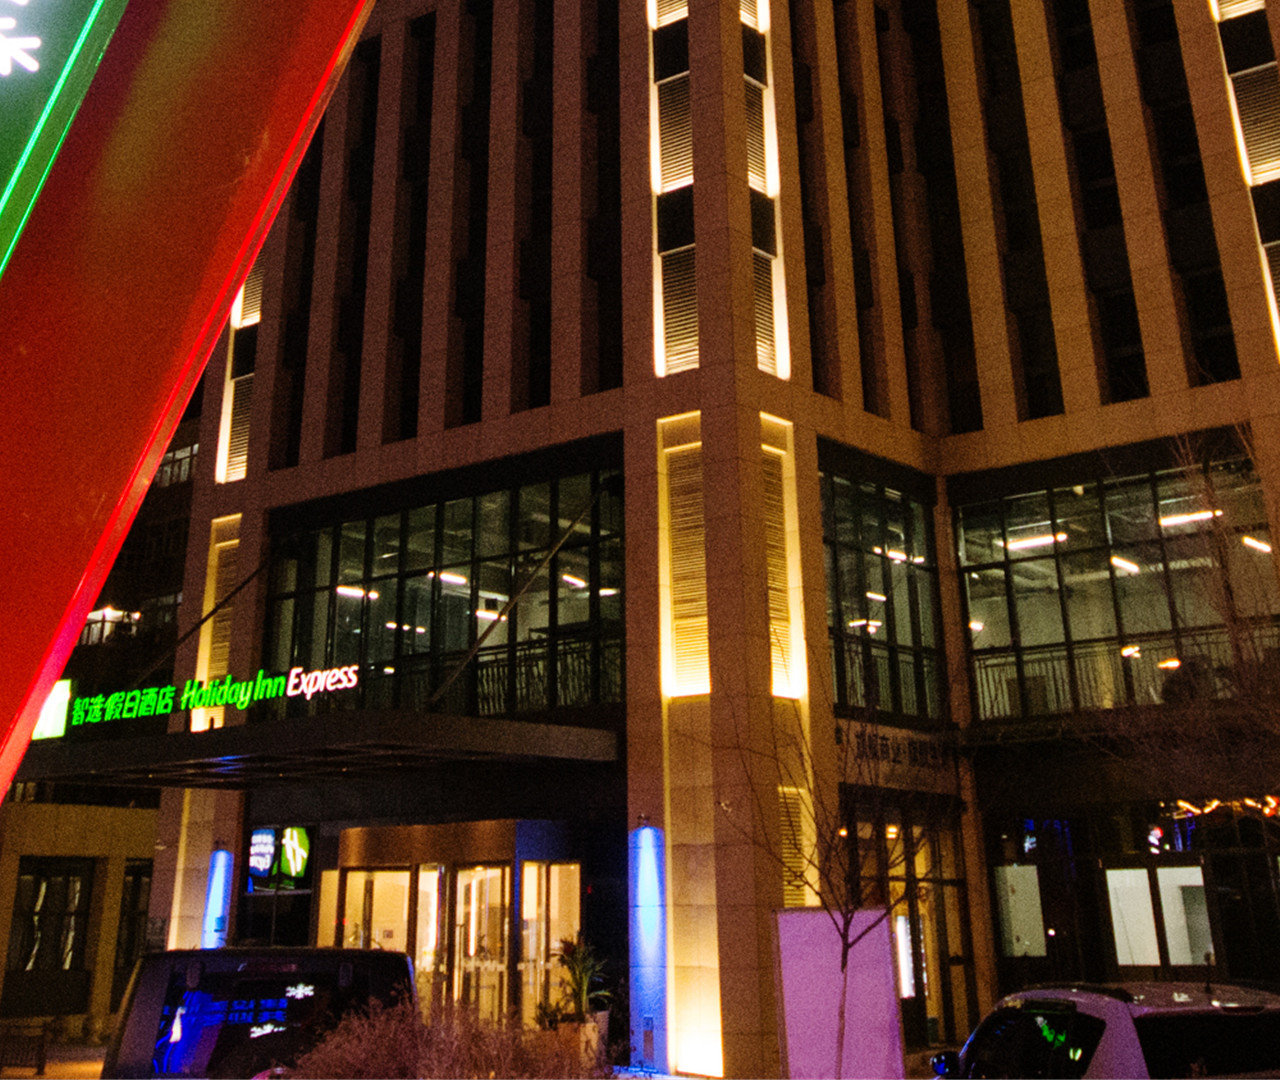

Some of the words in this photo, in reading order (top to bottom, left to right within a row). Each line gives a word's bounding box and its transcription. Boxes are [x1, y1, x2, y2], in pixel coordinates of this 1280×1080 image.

[71, 684, 176, 725] 智选假日酒店
[180, 675, 253, 710] Holiday
[252, 669, 287, 701] Inn
[286, 665, 359, 701] Express
